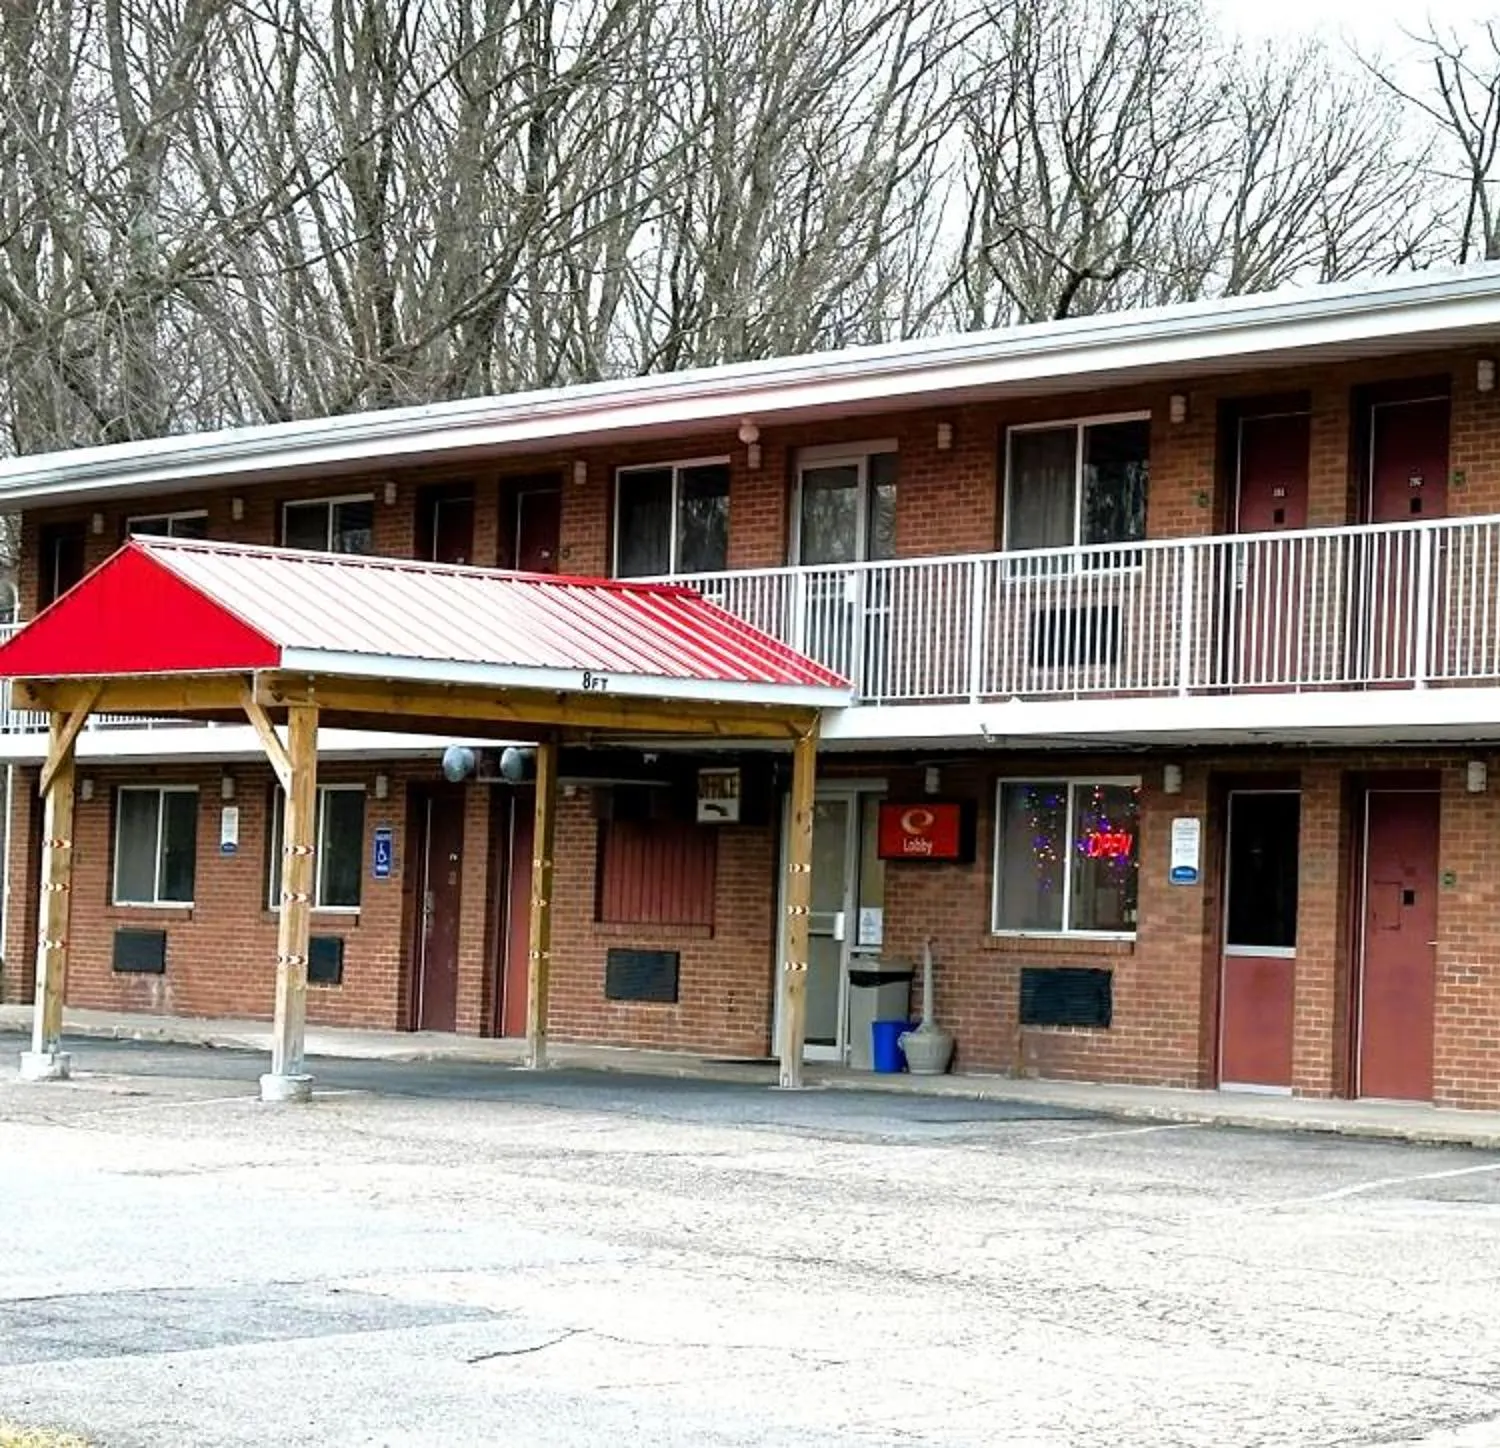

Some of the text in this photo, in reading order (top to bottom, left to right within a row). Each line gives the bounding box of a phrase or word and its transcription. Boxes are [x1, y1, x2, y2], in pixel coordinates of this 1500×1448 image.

[582, 671, 609, 690] 8FT
[903, 837, 933, 856] Lobby
[1088, 832, 1132, 857] OPEN
